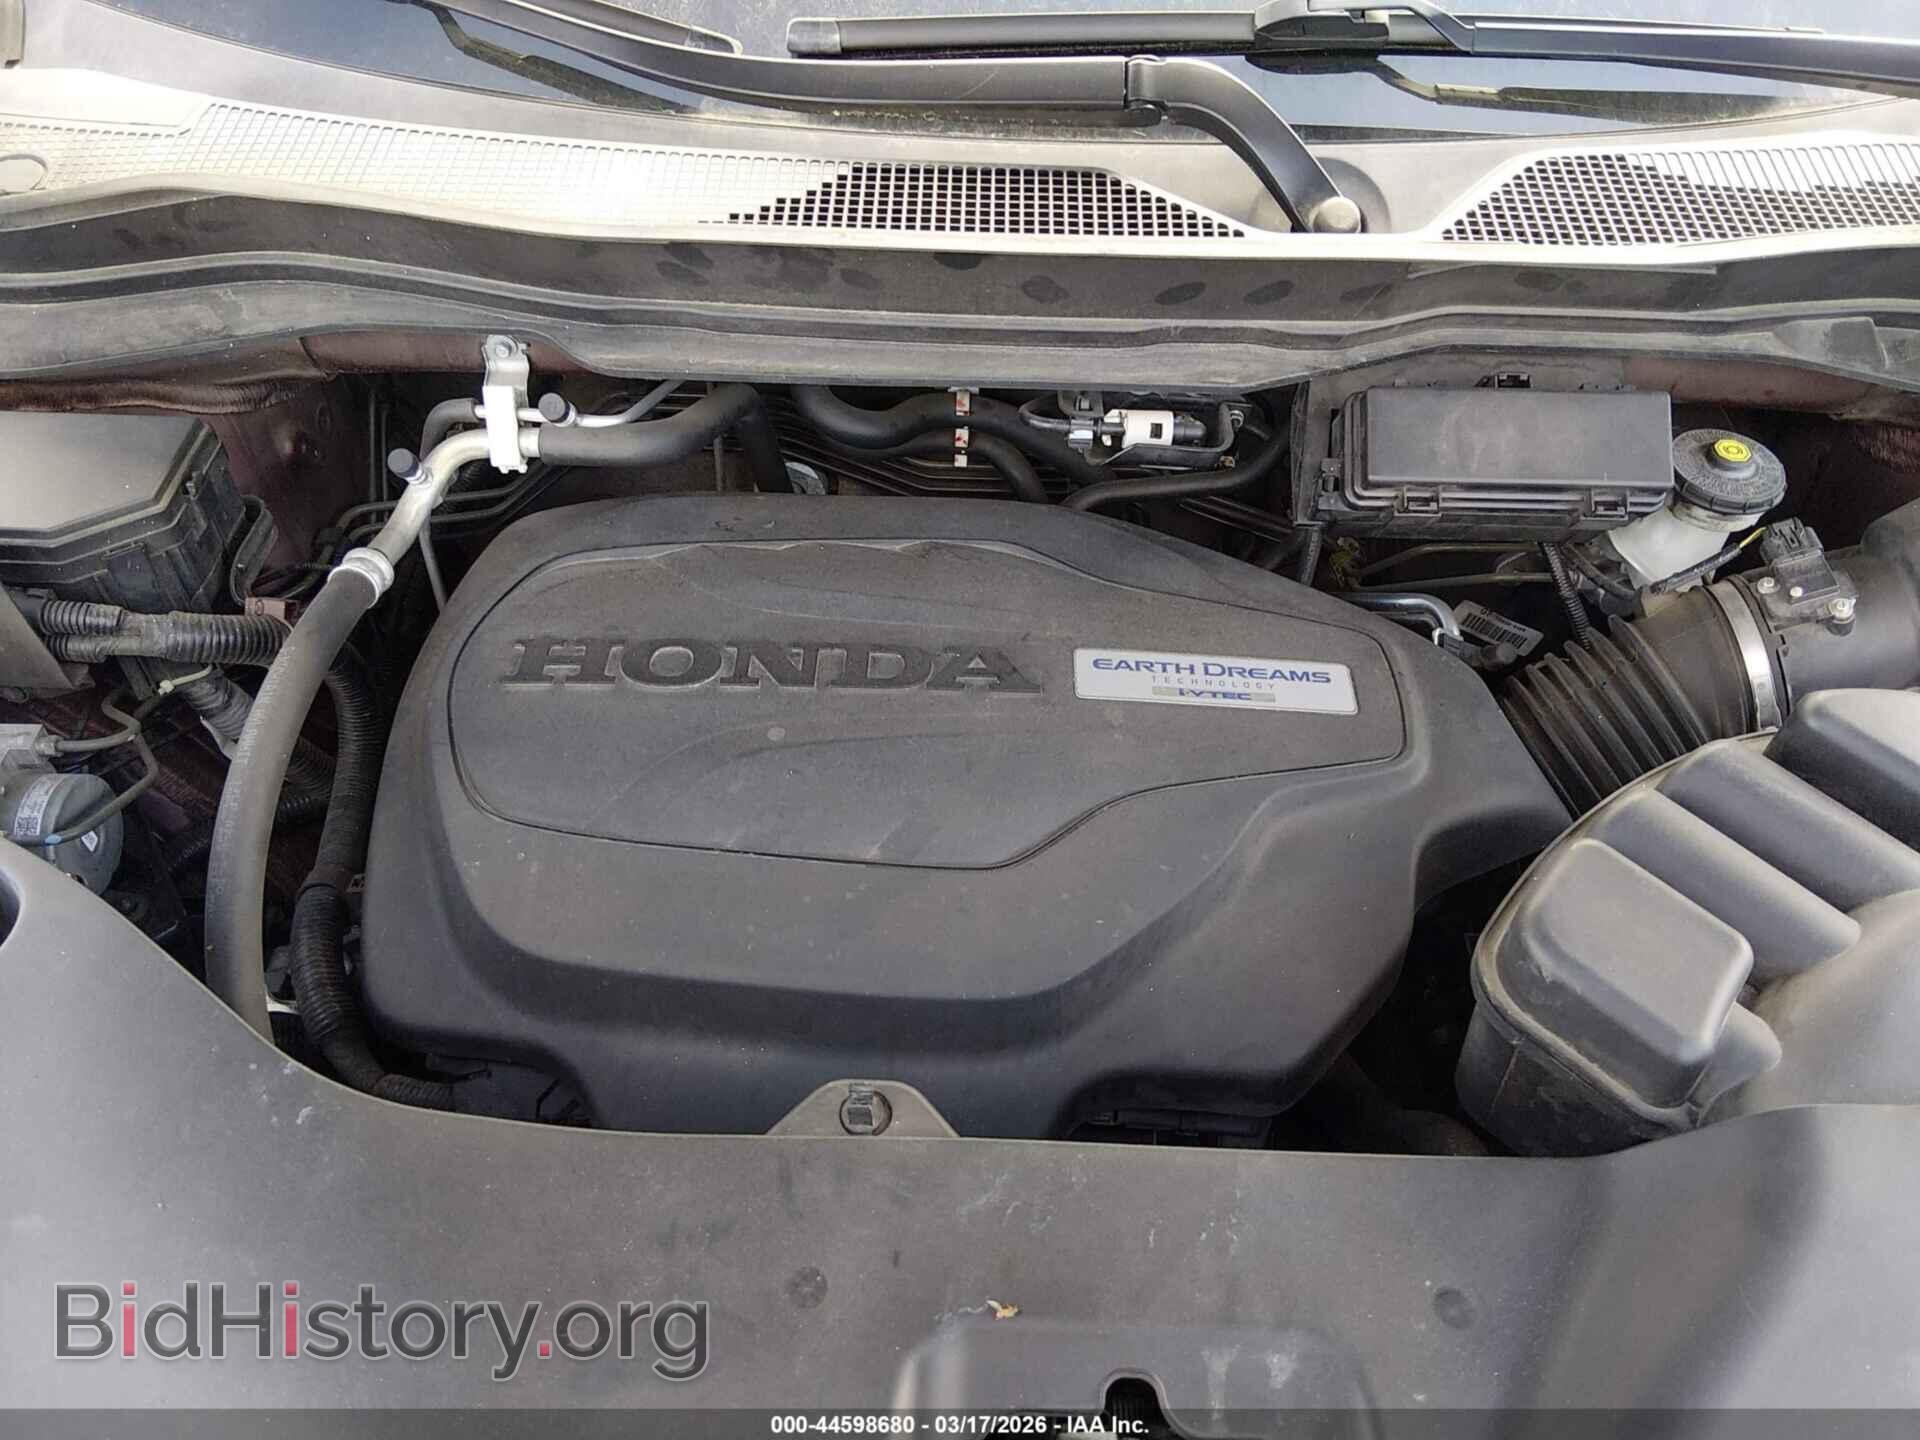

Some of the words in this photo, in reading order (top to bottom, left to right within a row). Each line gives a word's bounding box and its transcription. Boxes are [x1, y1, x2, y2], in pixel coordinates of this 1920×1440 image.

[502, 638, 1042, 696] HONDA
[1092, 658, 1195, 675] EARTH
[1204, 662, 1331, 684] DREAMS
[1152, 675, 1276, 689] TECHNOLOGY
